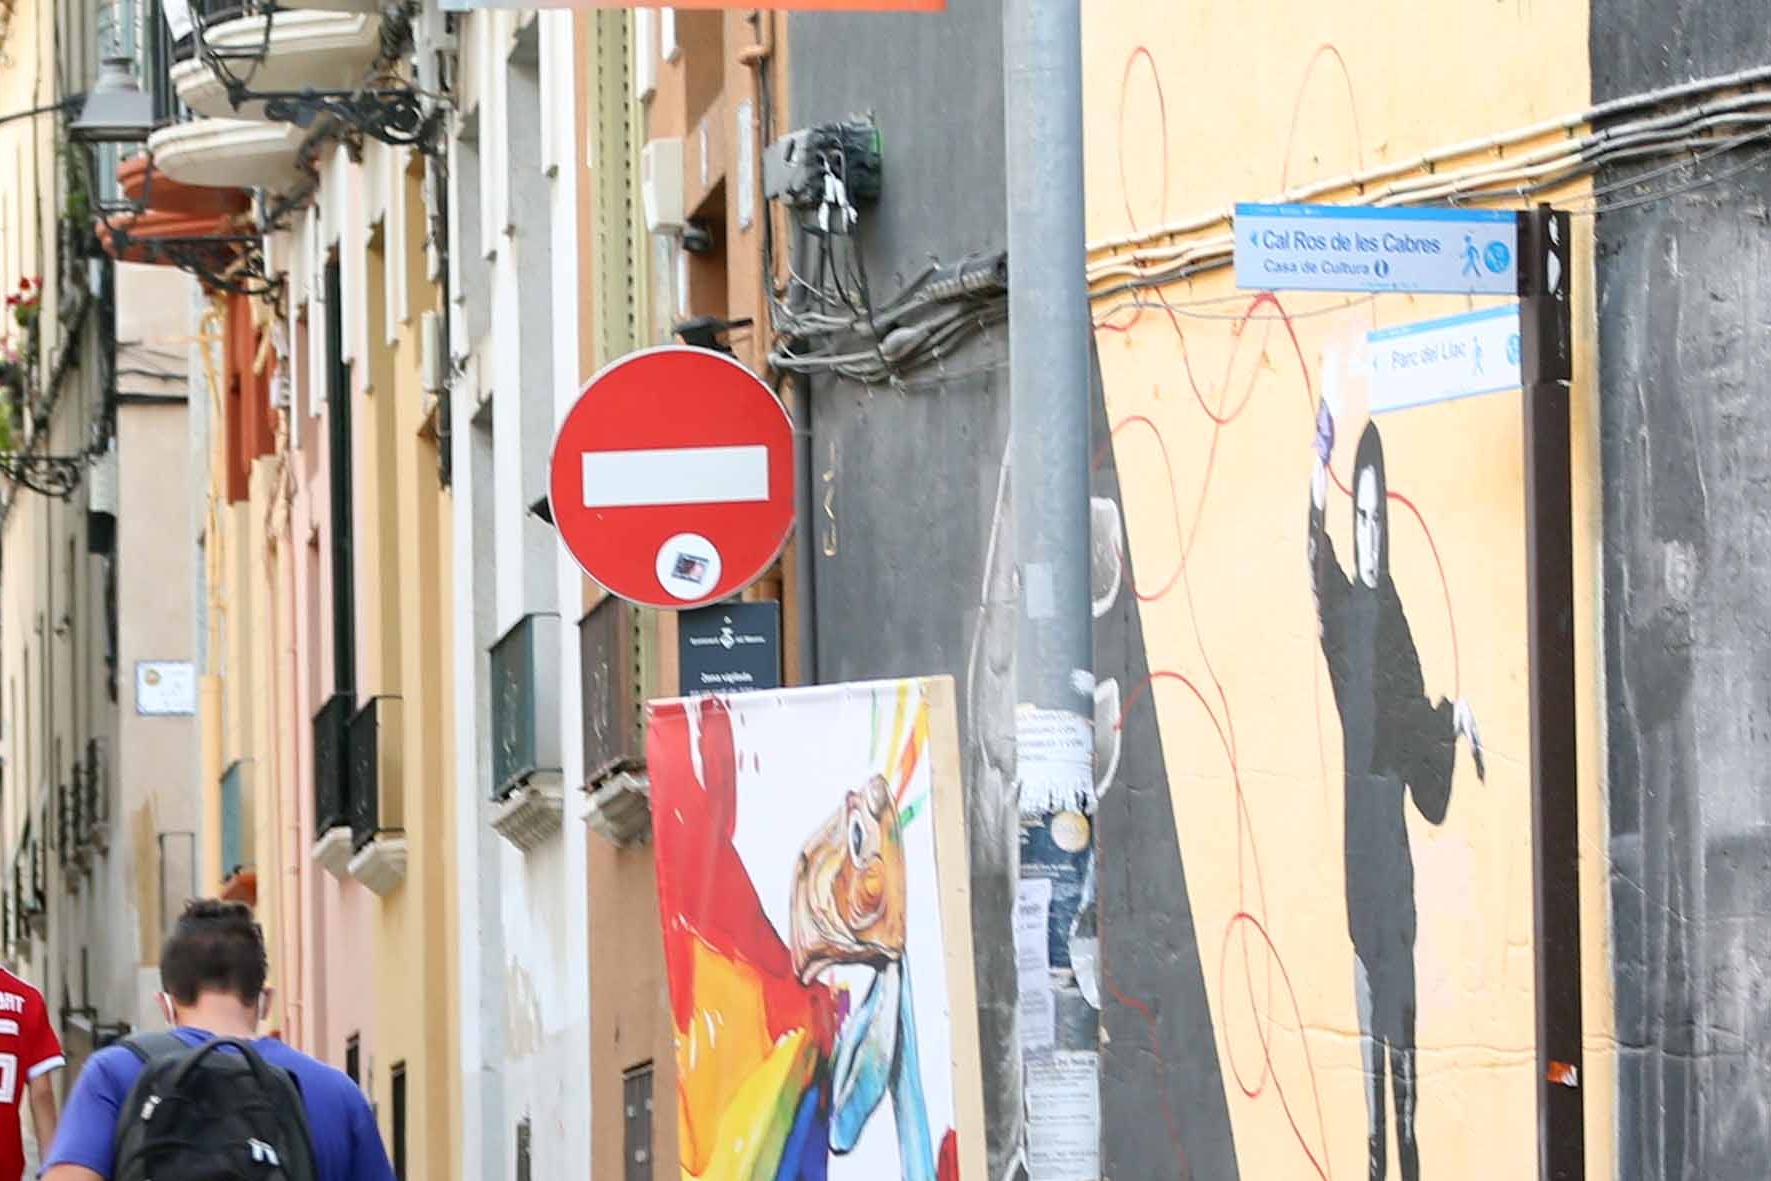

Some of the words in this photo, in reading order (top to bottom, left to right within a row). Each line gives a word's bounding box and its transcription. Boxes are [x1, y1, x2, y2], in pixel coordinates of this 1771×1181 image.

[1262, 229, 1291, 250] Cal
[1293, 231, 1327, 251] Ros
[1330, 232, 1352, 252] de
[1355, 232, 1379, 252] les
[1382, 233, 1443, 255] Cabres
[1263, 259, 1298, 274] Casa
[1300, 260, 1318, 275] de
[1321, 261, 1370, 276] Cultura
